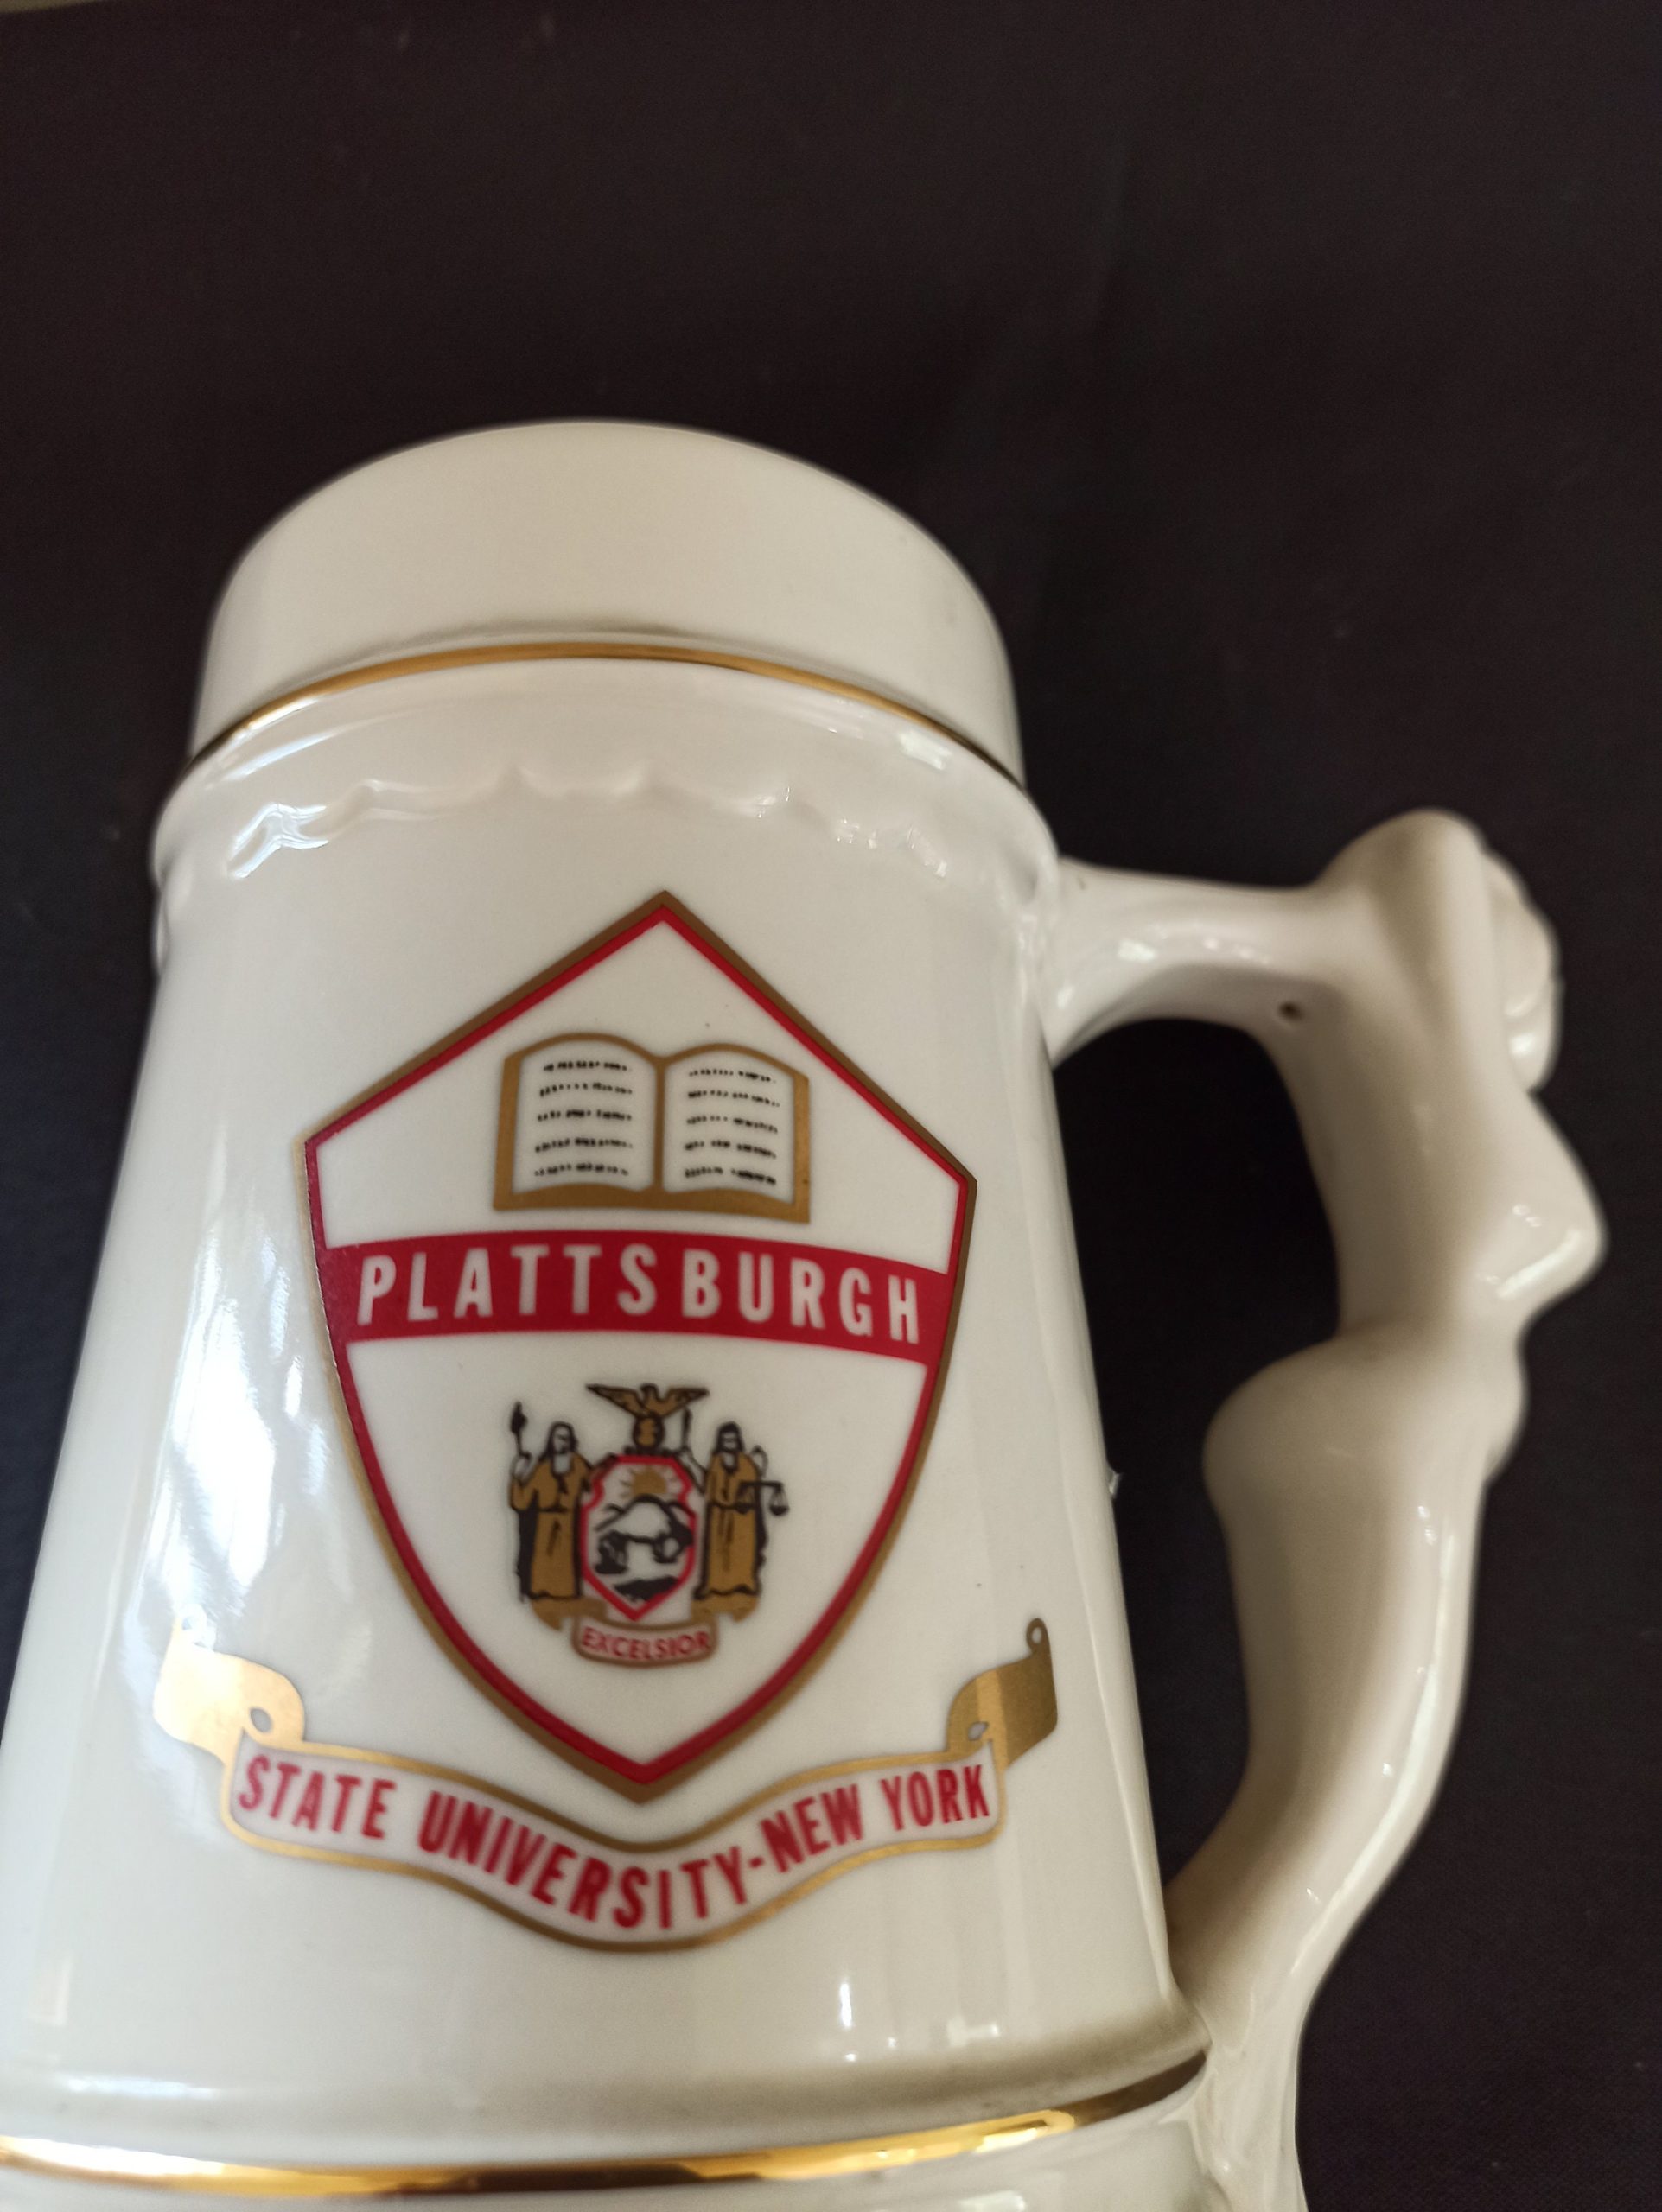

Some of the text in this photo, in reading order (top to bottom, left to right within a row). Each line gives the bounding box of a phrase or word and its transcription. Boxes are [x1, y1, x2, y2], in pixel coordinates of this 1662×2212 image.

[356, 1243, 920, 1345] PLATTSBURGH
[582, 1626, 710, 1660] EXCELSIOR
[239, 1754, 396, 1840] STATE
[878, 1764, 990, 1832] YORK
